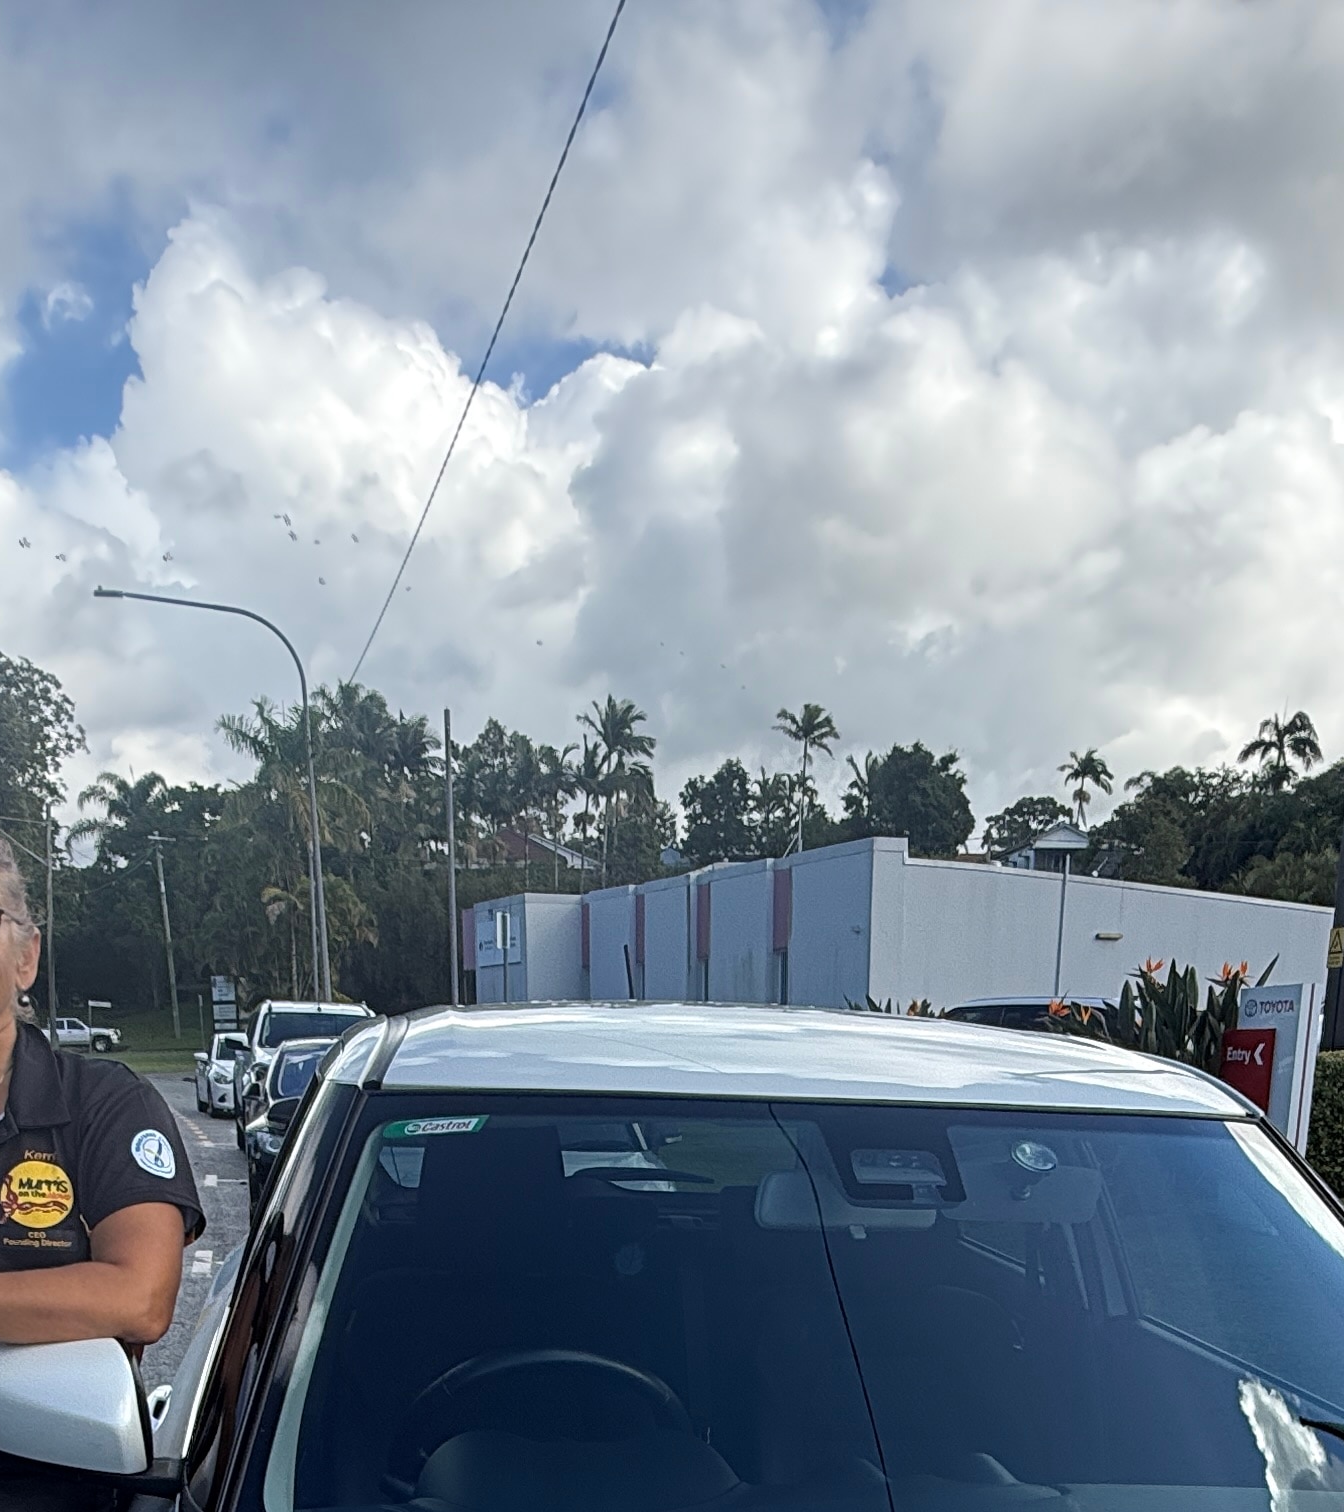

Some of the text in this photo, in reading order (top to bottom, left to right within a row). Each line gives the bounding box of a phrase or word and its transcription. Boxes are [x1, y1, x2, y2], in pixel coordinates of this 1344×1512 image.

[1259, 1000, 1295, 1014] TOYOTA
[1226, 1047, 1251, 1065] Entry
[421, 1120, 472, 1132] Castrol
[18, 1177, 68, 1193] Murris
[31, 1189, 46, 1198] the
[28, 1231, 46, 1239] CEO
